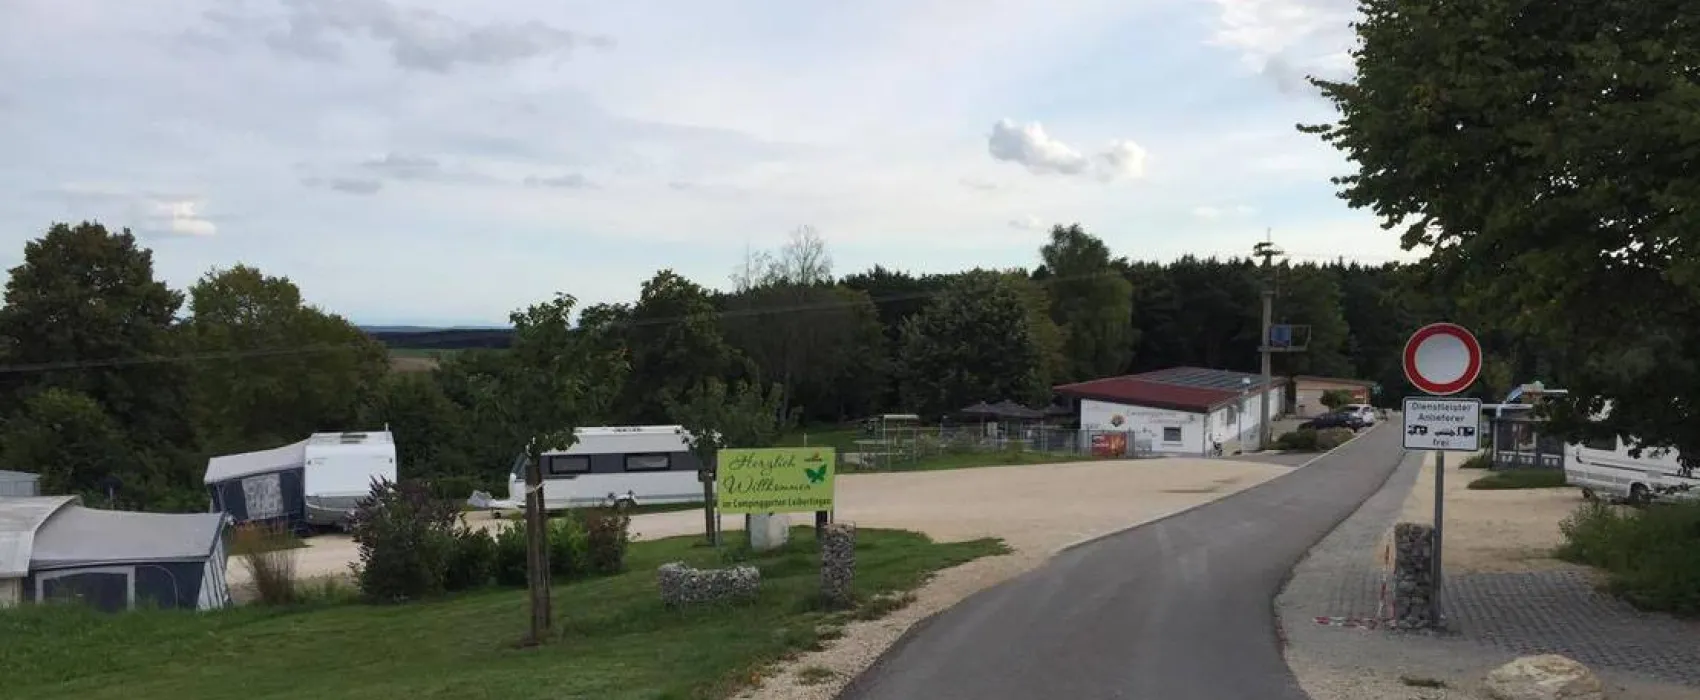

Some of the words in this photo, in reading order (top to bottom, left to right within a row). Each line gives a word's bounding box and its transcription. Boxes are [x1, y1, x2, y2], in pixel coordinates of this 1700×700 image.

[1412, 402, 1471, 411] Dienstleister
[1433, 438, 1449, 447] frei
[728, 453, 796, 475] Herzlich
[723, 474, 811, 494] Willkommen
